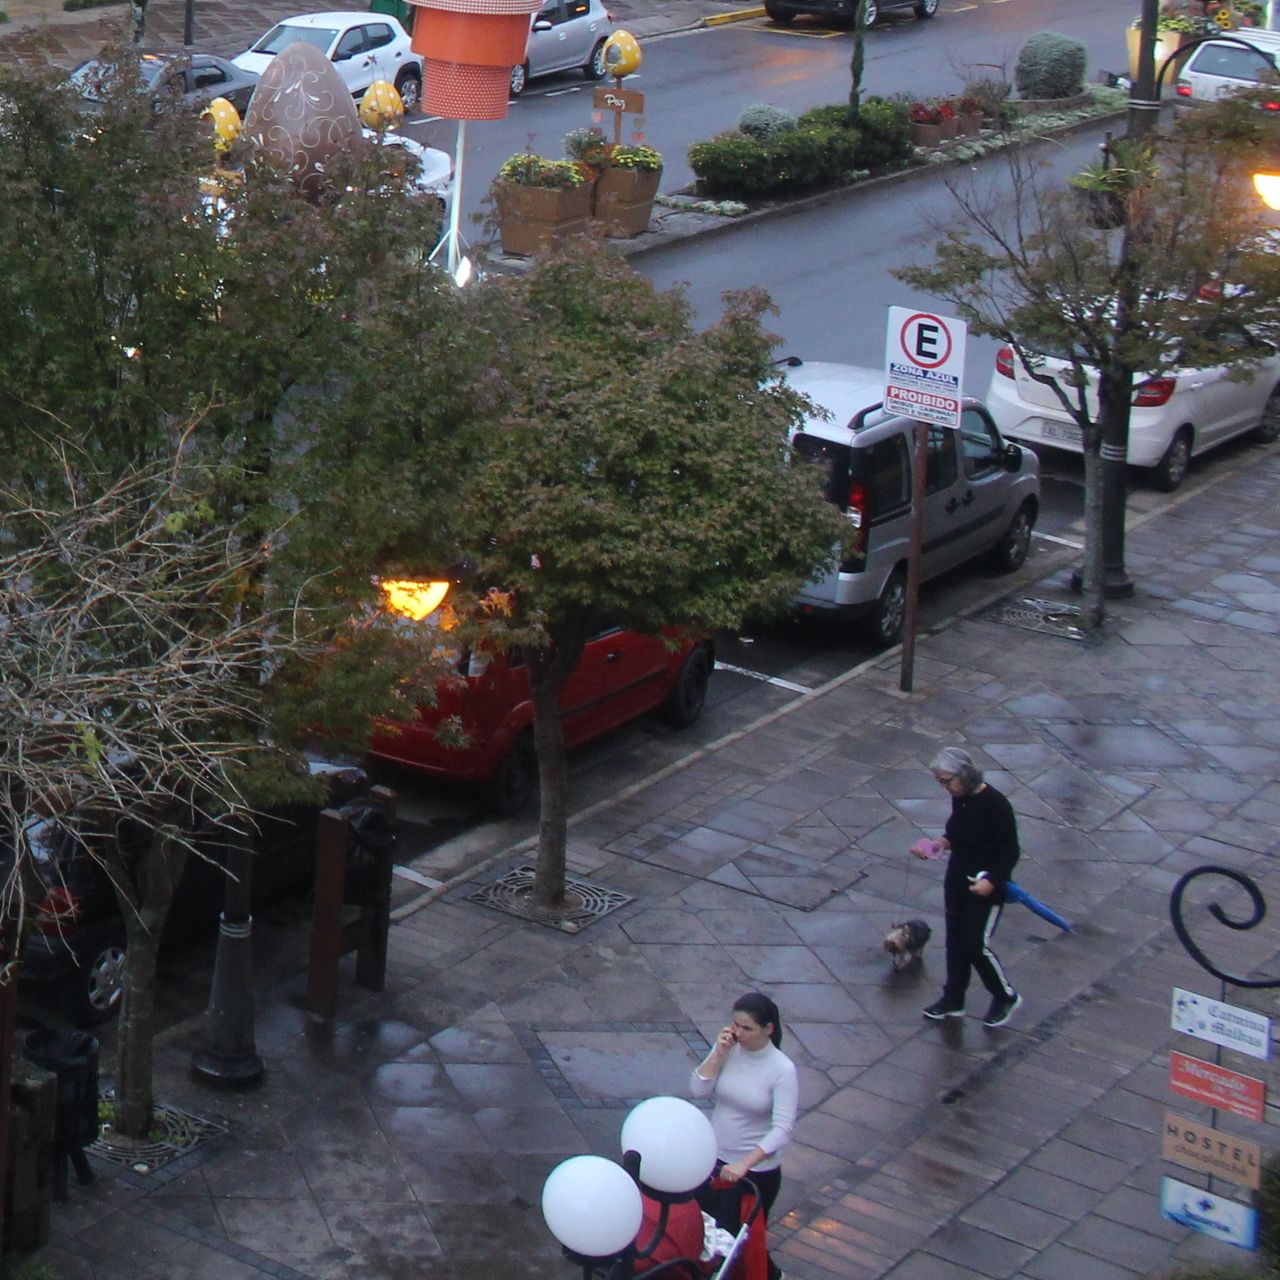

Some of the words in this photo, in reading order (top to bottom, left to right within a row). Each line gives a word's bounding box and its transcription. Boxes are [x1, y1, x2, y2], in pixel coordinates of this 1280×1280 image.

[916, 322, 939, 360] E
[892, 363, 924, 377] ZONA
[926, 370, 956, 384] AZUL
[890, 387, 956, 410] PROIBIDO
[1167, 1124, 1257, 1167] HOSTEL
